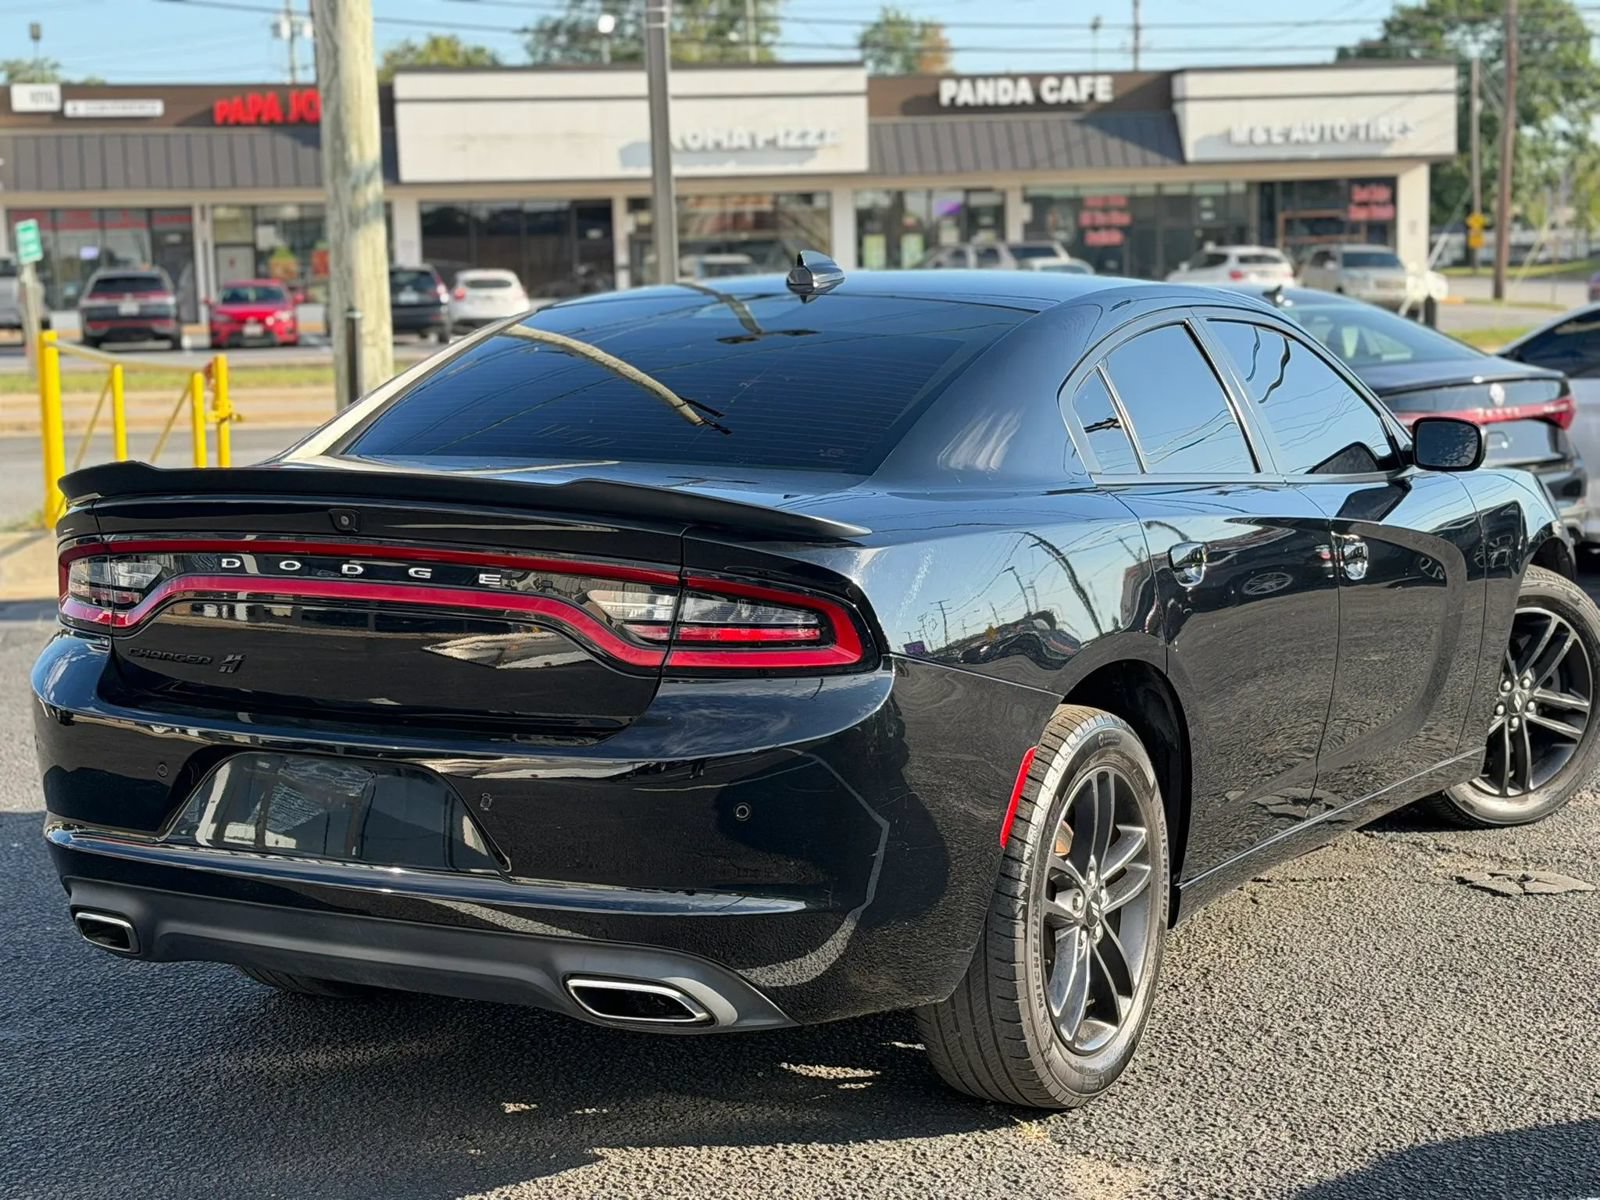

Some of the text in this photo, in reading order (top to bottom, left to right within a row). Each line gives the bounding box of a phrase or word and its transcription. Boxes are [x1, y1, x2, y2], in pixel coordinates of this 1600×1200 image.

[939, 75, 1115, 107] PANDA CAFE
[214, 91, 283, 126] PAPA
[1288, 118, 1351, 143] AUTO
[1356, 115, 1417, 142] TIRES
[221, 557, 502, 586] DODGE
[128, 646, 214, 666] CHARGER
